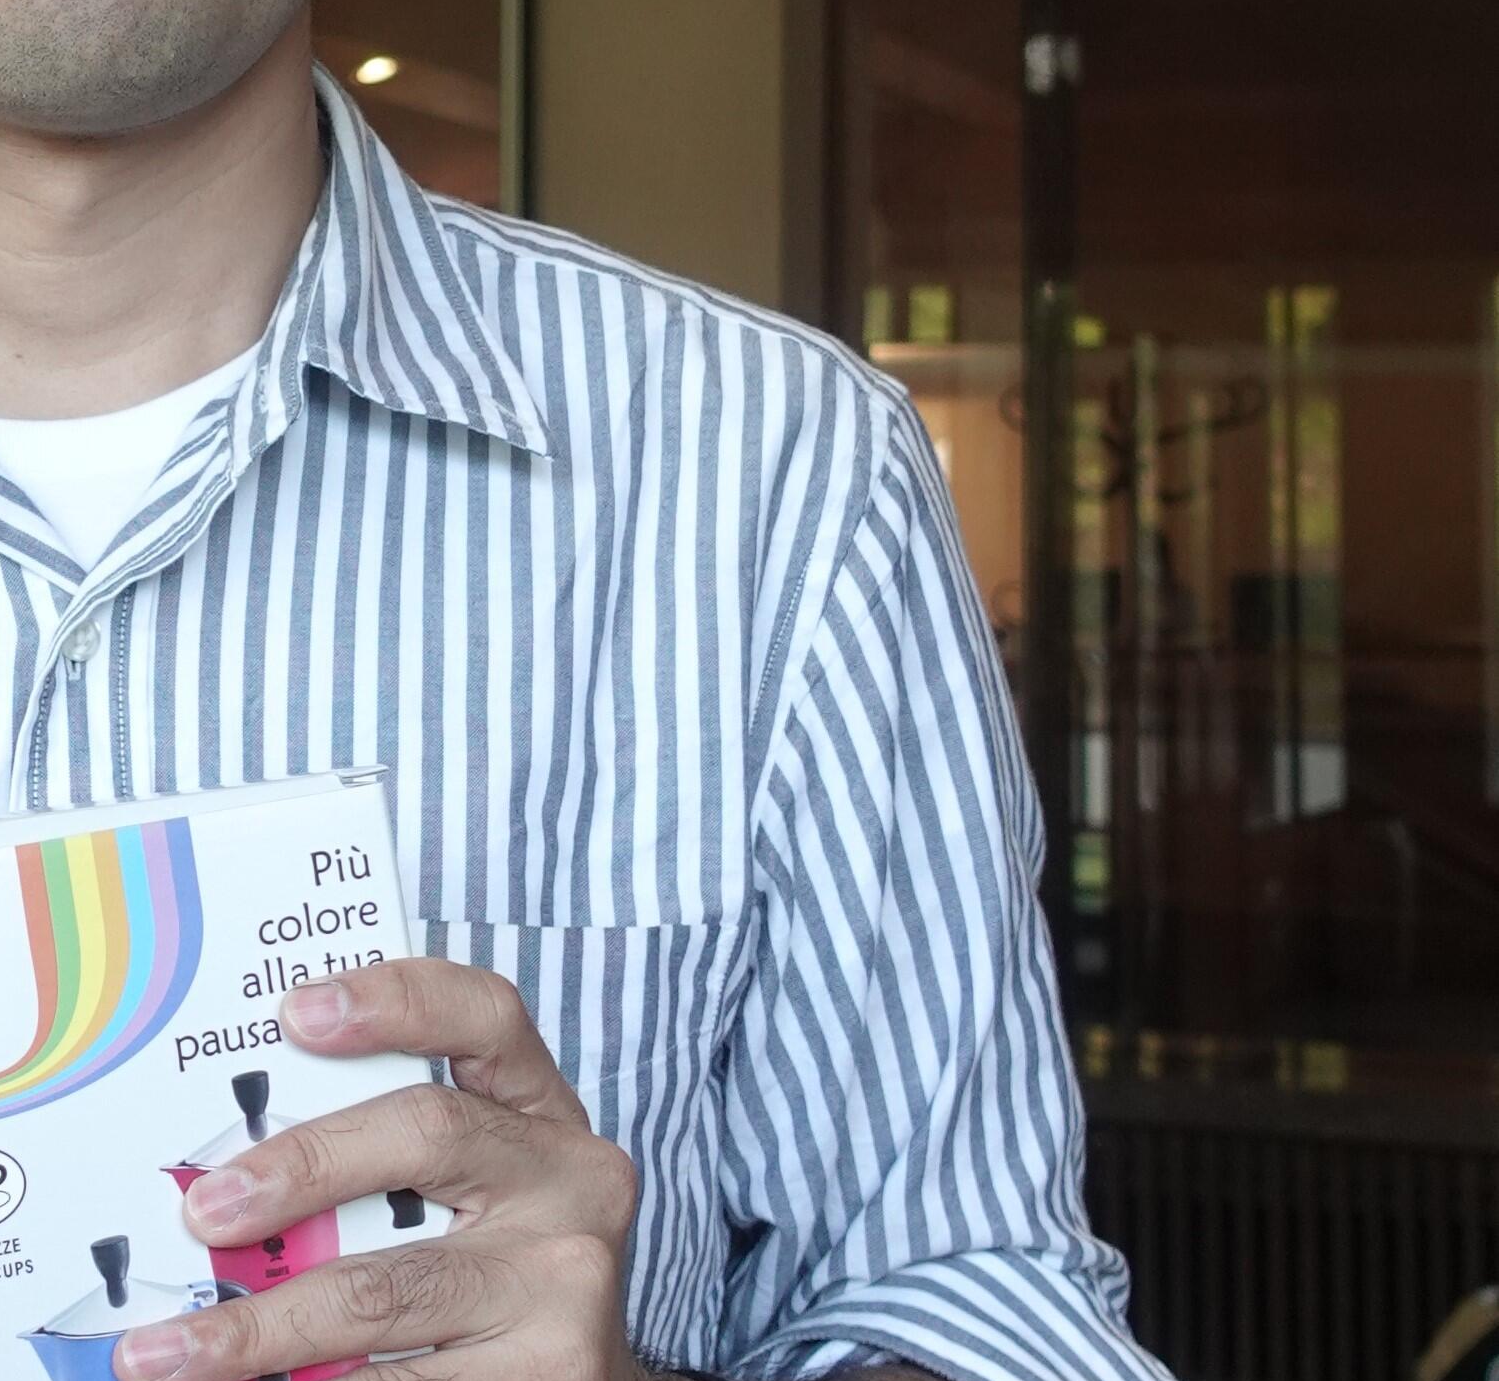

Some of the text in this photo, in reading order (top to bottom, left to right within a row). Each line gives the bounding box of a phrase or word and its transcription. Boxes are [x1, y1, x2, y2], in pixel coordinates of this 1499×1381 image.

[310, 845, 371, 886] Più
[258, 900, 379, 945] colore
[242, 956, 309, 999] alla
[174, 1017, 282, 1072] pausa
